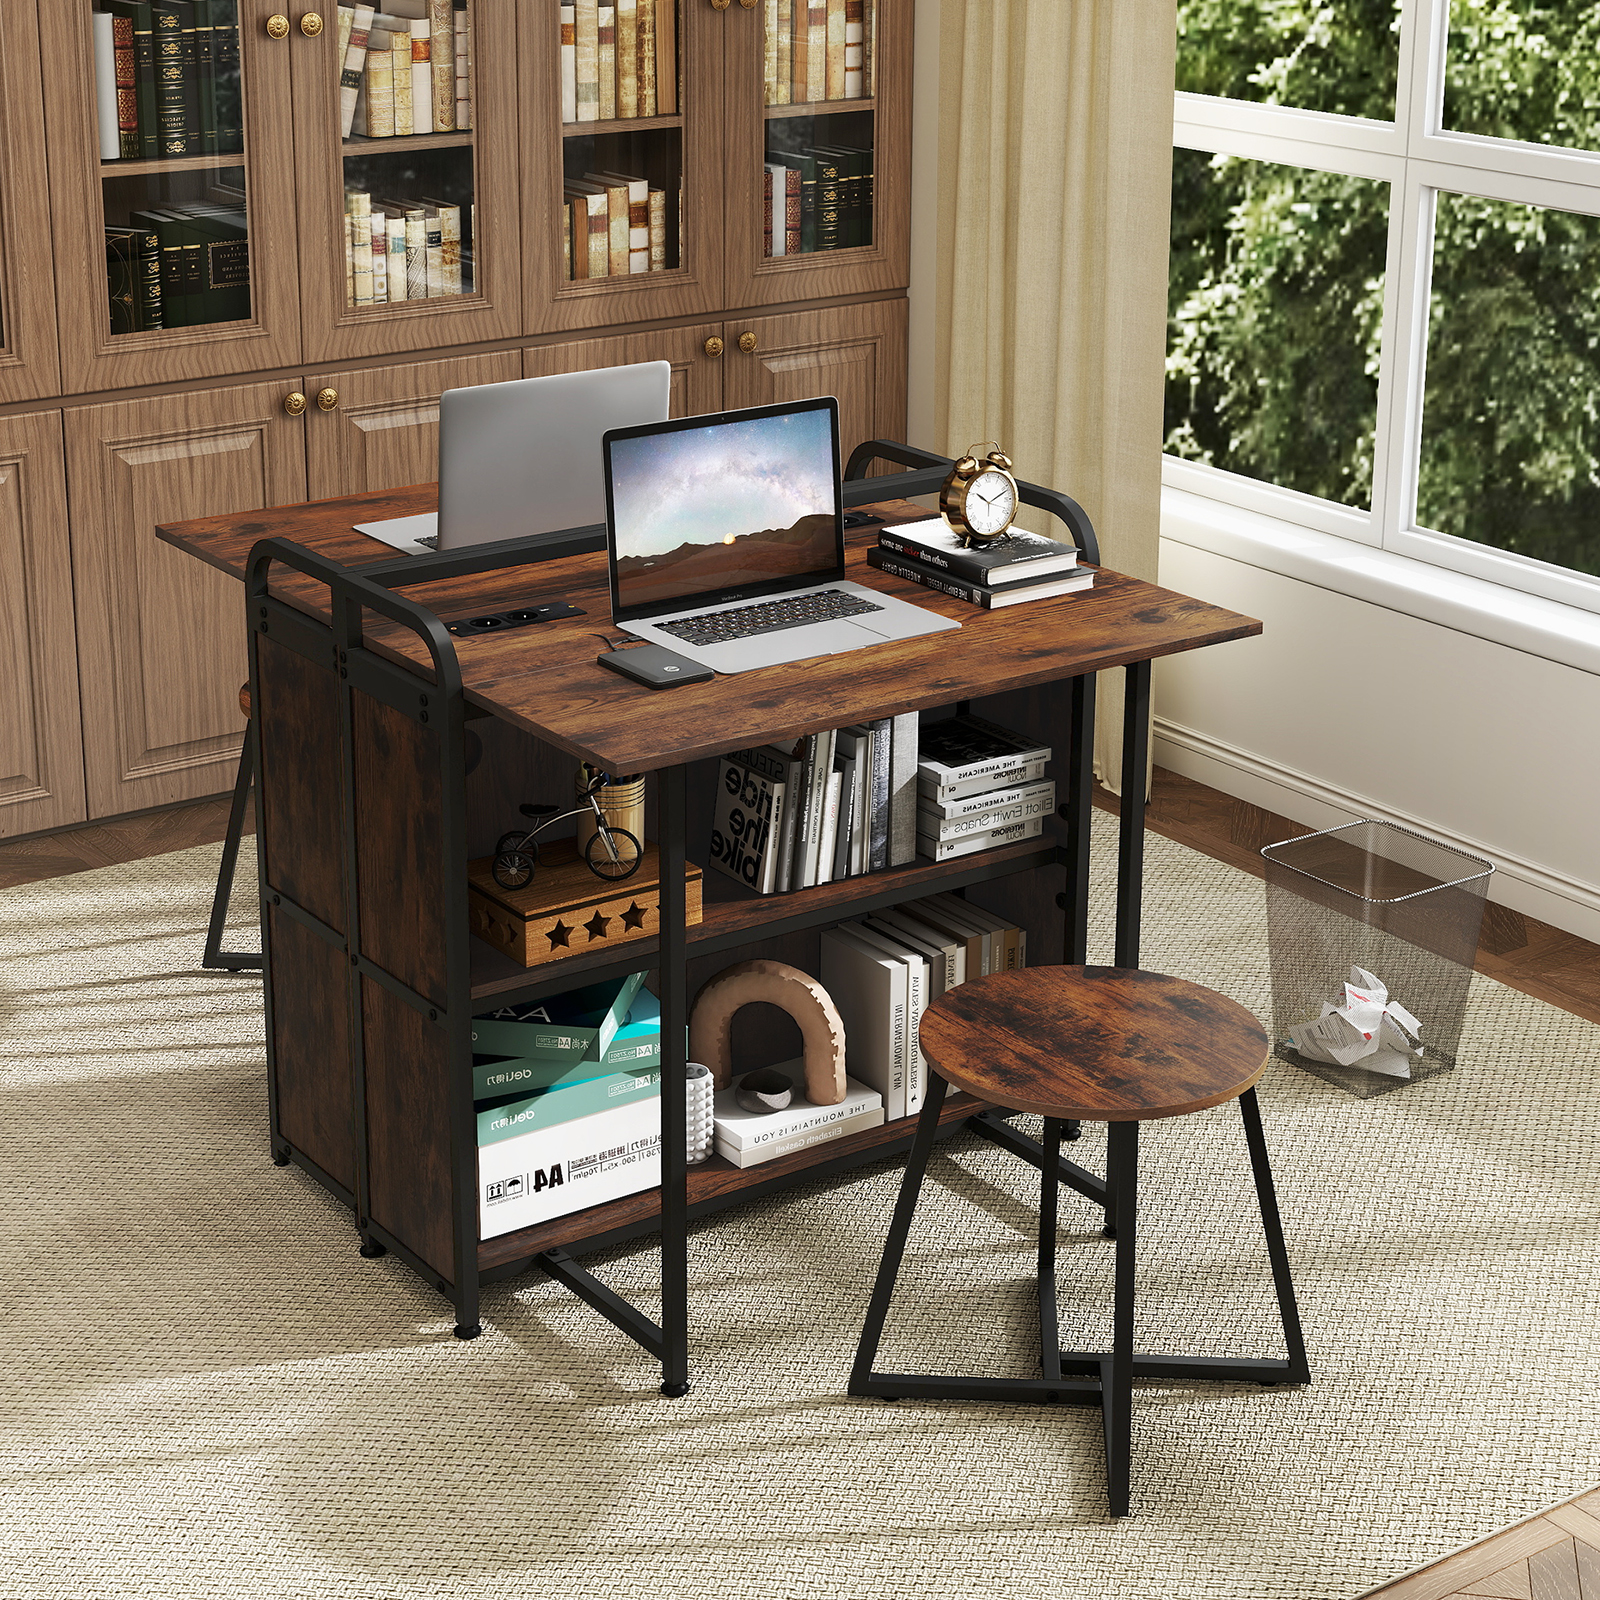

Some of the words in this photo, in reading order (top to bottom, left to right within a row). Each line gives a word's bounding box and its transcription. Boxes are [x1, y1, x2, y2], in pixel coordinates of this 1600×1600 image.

[880, 538, 894, 549] some
[894, 543, 903, 552] are
[919, 550, 932, 562] than
[931, 554, 949, 568] others
[958, 588, 968, 600] THE
